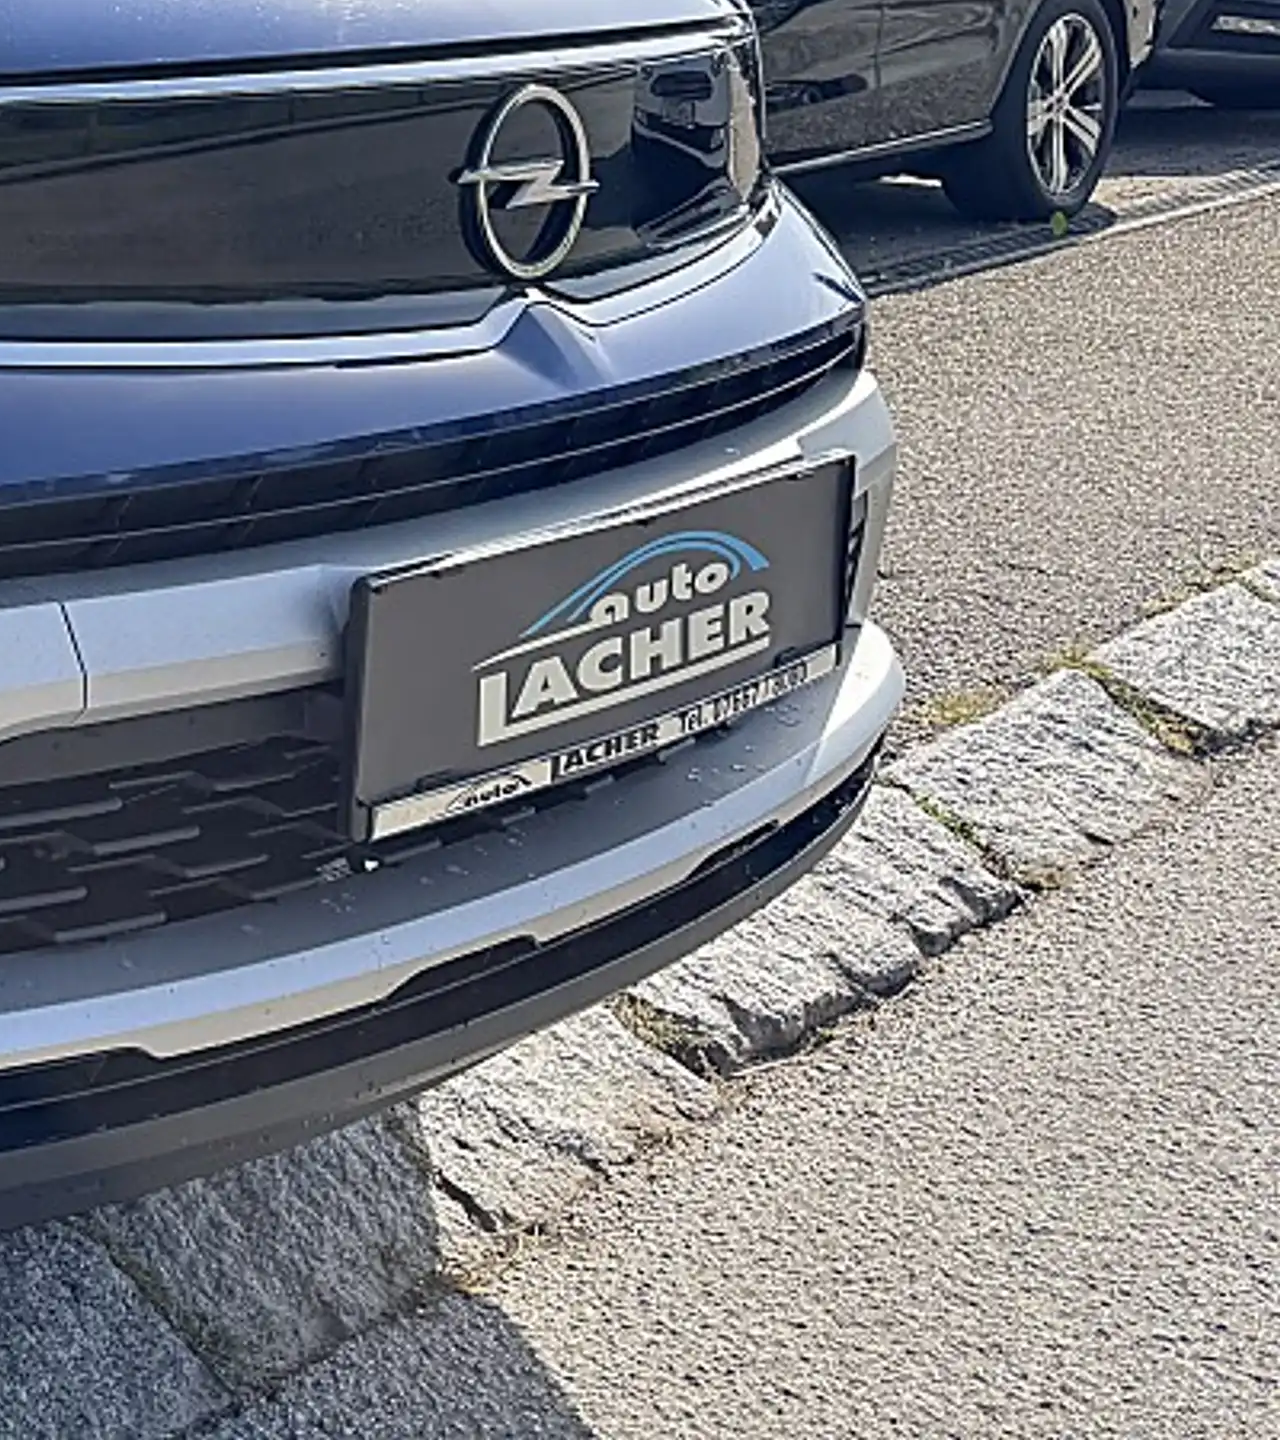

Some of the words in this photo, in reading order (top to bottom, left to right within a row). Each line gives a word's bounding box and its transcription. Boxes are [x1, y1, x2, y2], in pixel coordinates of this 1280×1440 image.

[589, 561, 730, 626] auto
[477, 591, 772, 748] LACHER
[550, 723, 660, 781] LACHER
